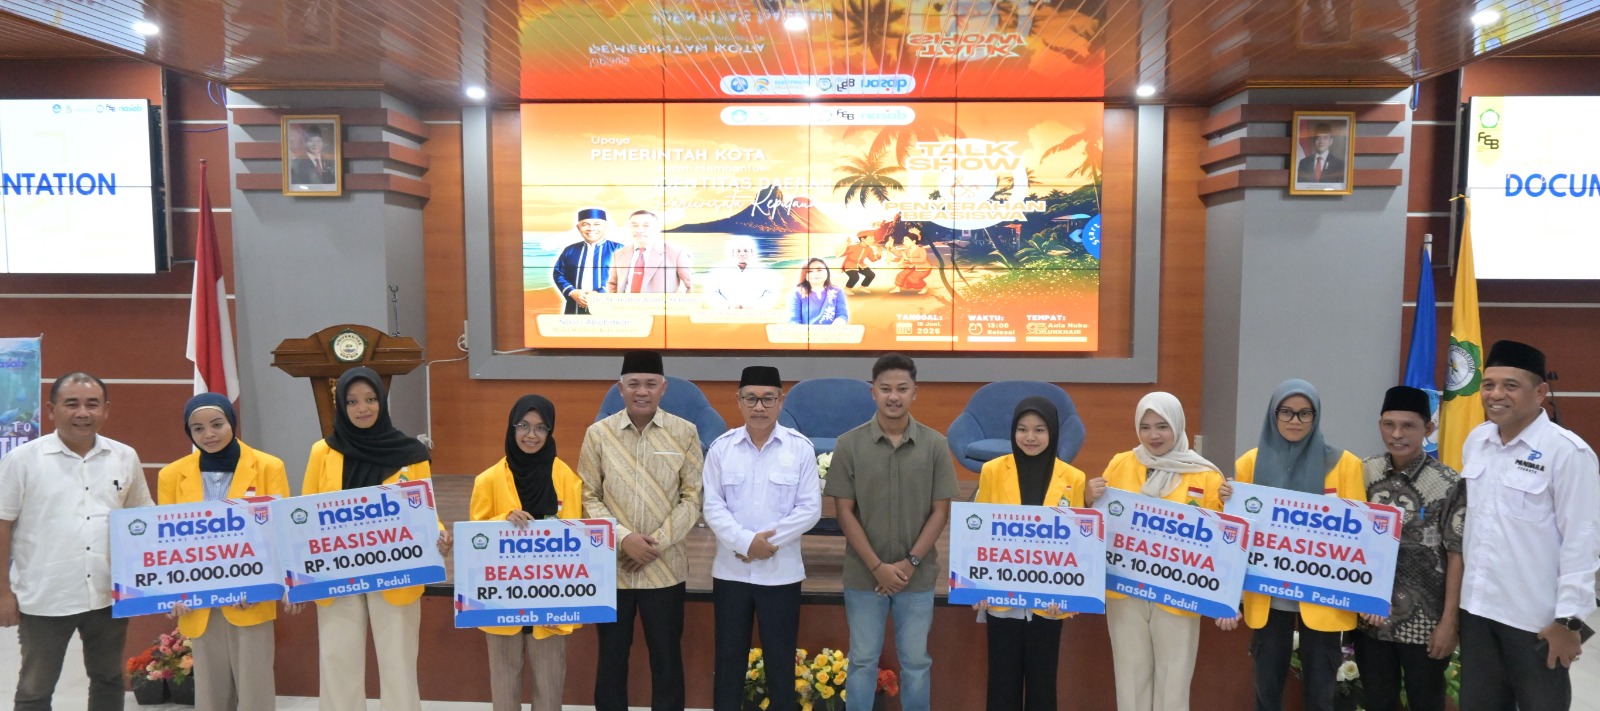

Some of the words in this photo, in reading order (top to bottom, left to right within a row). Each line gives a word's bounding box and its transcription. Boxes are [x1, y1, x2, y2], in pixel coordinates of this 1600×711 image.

[837, 109, 855, 121] FEB
[591, 136, 631, 146] Upaya
[919, 143, 1014, 157] TALK
[1477, 131, 1500, 150] FEB
[591, 148, 708, 161] PEMERINTAH
[715, 148, 766, 161] KOTA
[908, 157, 1020, 171] SHOW
[0, 173, 116, 195] NTATION
[884, 202, 1045, 211] PENYERAHAN
[903, 211, 1025, 220] BEASISWA
[316, 498, 358, 509] YAYASAN
[318, 493, 400, 526] nasab
[1134, 503, 1175, 517] YAYASAN
[1274, 498, 1319, 511] YAYASAN
[157, 510, 202, 521] YAYASAN
[158, 507, 245, 538] nasab
[992, 513, 1032, 521] YAYASAN
[1272, 506, 1362, 535] nasab
[991, 516, 1071, 540] nasab
[1132, 511, 1213, 543] nasab
[309, 526, 414, 555] BEASISWA
[500, 528, 581, 554] nasab
[1253, 531, 1367, 566] BEASISWA
[143, 542, 255, 568] BEASISWA
[305, 559, 330, 574] RP.
[333, 544, 423, 569] 10.000.000
[977, 546, 1078, 567] BEASISWA
[1113, 533, 1215, 572] BEASISWA
[135, 573, 162, 587] RP.
[166, 561, 263, 584] 10.000.000
[485, 563, 589, 581] BEASISWA
[969, 566, 992, 580] RP.
[996, 568, 1085, 586] 10.000.000
[1106, 551, 1126, 568] RP.
[1130, 558, 1220, 591] 10.000.000
[1273, 555, 1373, 586] 10.000.000
[328, 578, 370, 595] nasab
[377, 574, 411, 588] Peduli
[477, 586, 502, 600] RP.
[506, 583, 597, 599] 10.000.000
[157, 594, 203, 610] naab
[210, 592, 247, 605] Peduli
[987, 592, 1027, 607] nasab
[1116, 582, 1156, 600] nasab
[1163, 594, 1198, 611] Peduli
[1259, 582, 1304, 599] nasab
[1312, 591, 1350, 608] Peduli
[497, 610, 539, 624] nasab
[546, 612, 580, 622] Peduli
